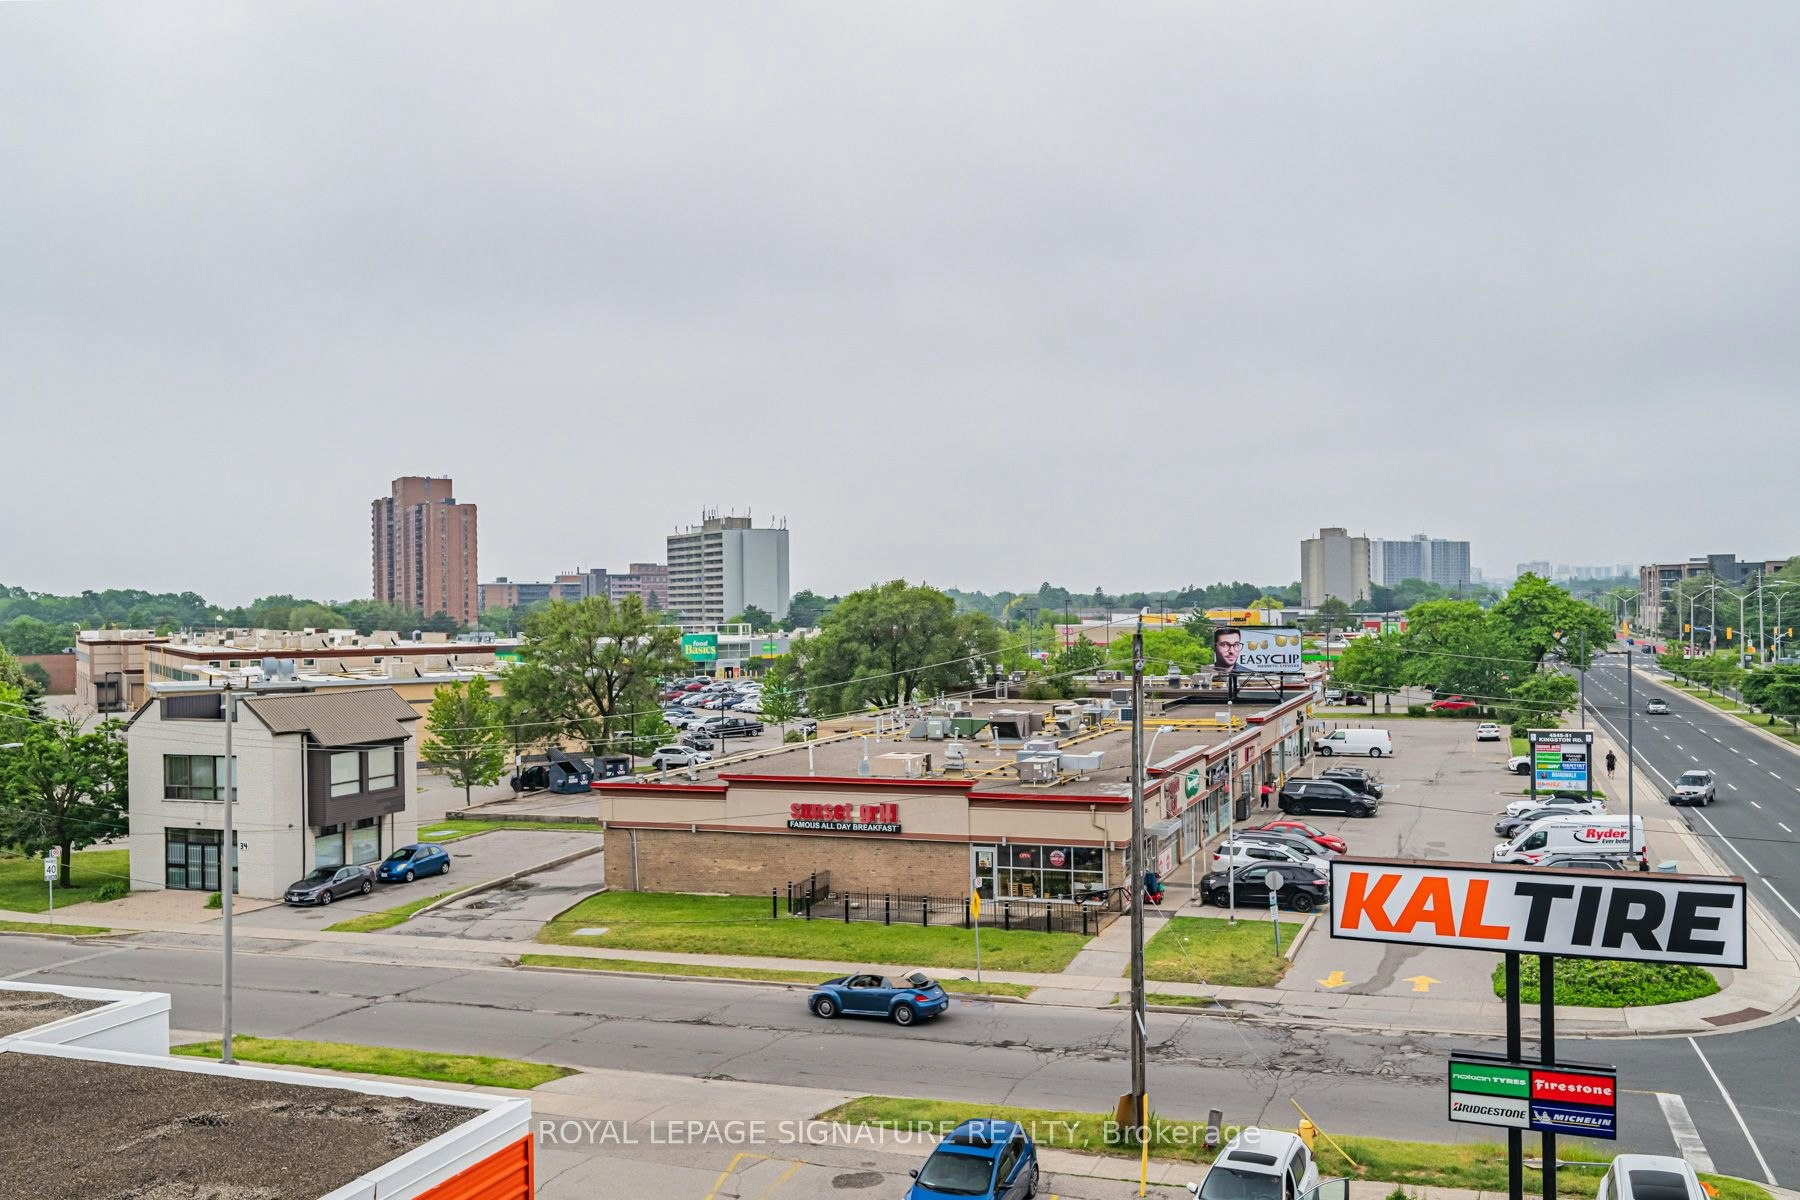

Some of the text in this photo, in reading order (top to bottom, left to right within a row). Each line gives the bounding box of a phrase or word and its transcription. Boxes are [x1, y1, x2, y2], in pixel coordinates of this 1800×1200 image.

[685, 645, 716, 655] Basics
[1240, 654, 1300, 664] EASYCLIP
[790, 803, 898, 824] sunset grill
[790, 821, 897, 832] FAMOUS ALL DAY BREAKFAST
[1586, 829, 1627, 840] Ryder
[240, 842, 248, 850] 34
[46, 865, 57, 874] 40
[1340, 872, 1735, 955] KAL TIRE
[1453, 1073, 1527, 1086] nokian TYRES
[1534, 1079, 1612, 1096] Firestone
[1452, 1102, 1527, 1119] BRIDGESTONE
[1553, 1113, 1612, 1126] MICHELIN
